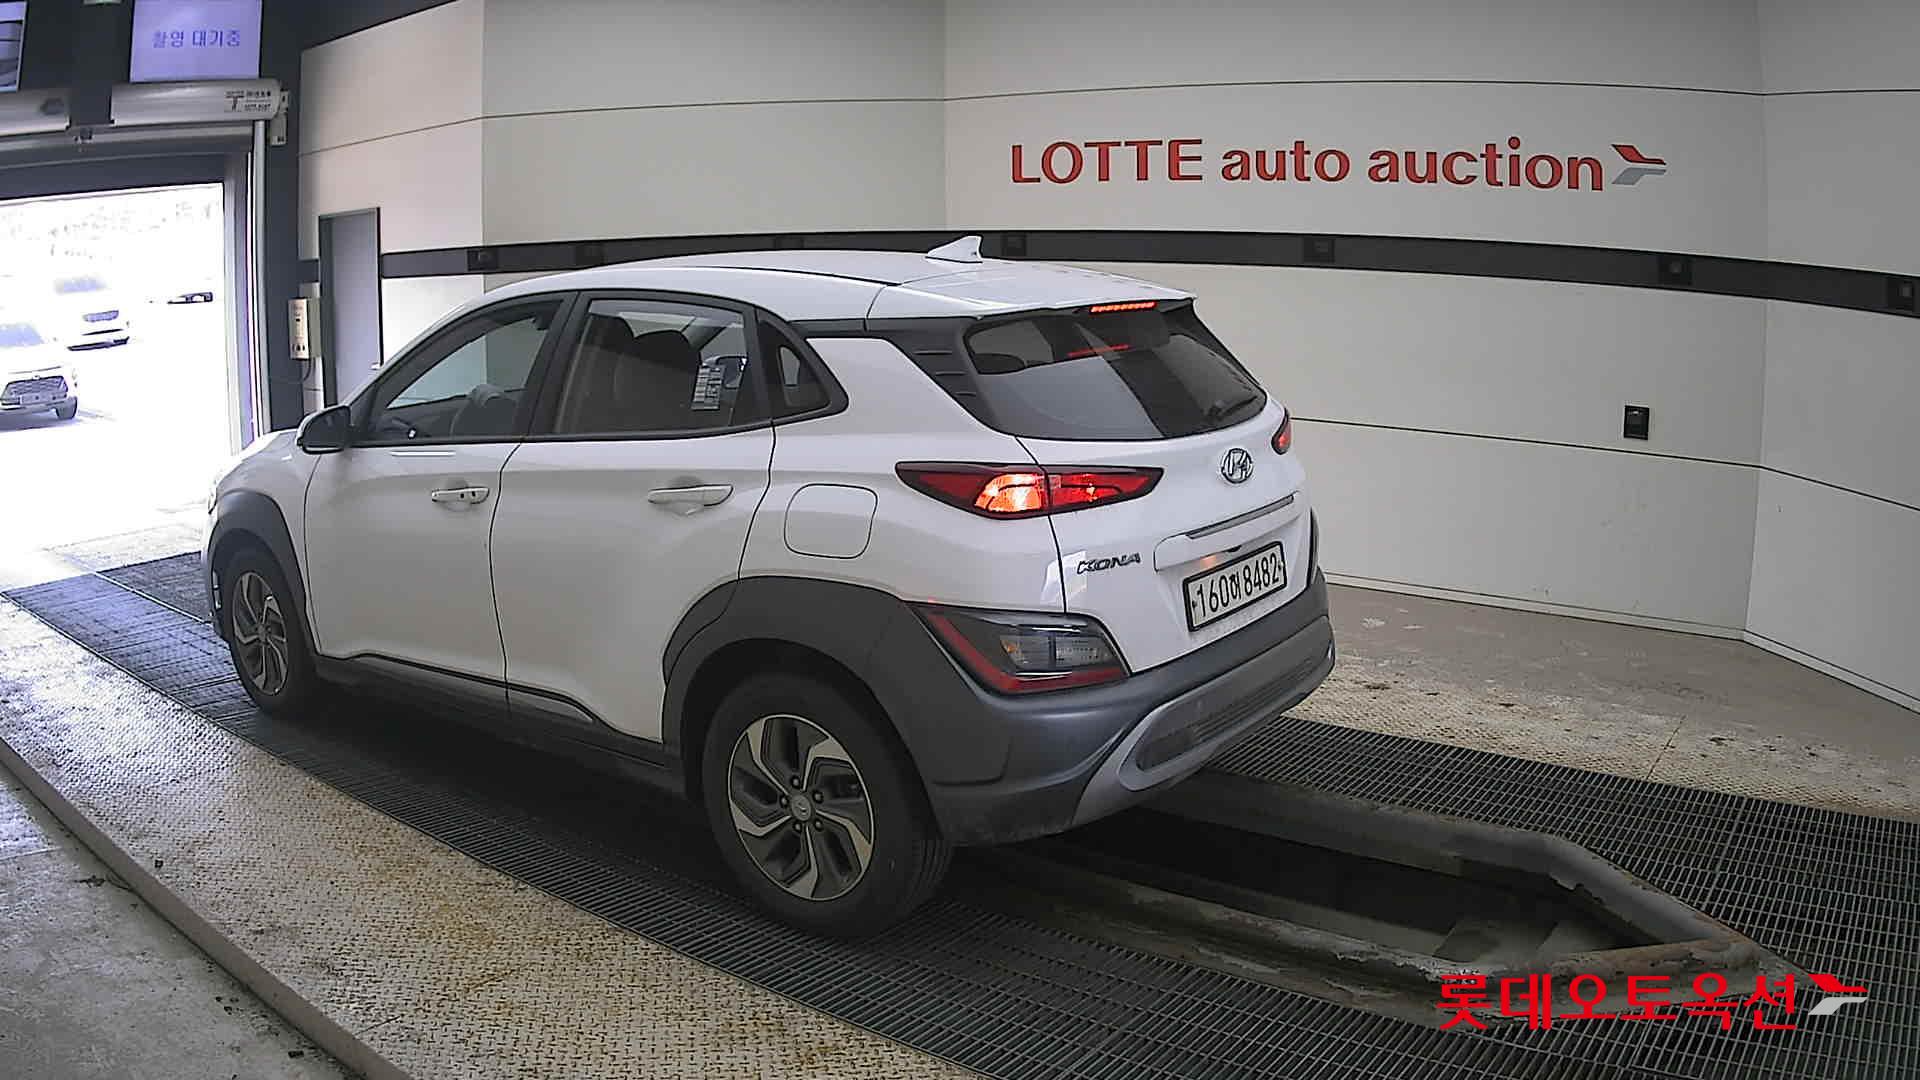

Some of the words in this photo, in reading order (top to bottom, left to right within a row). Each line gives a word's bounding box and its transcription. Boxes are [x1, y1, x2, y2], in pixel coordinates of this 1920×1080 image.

[192, 30, 241, 48] 대기중
[1011, 139, 1203, 184] LOTTE
[1220, 140, 1351, 182] auto
[1367, 136, 1604, 191] auction
[1077, 552, 1141, 575] KONA
